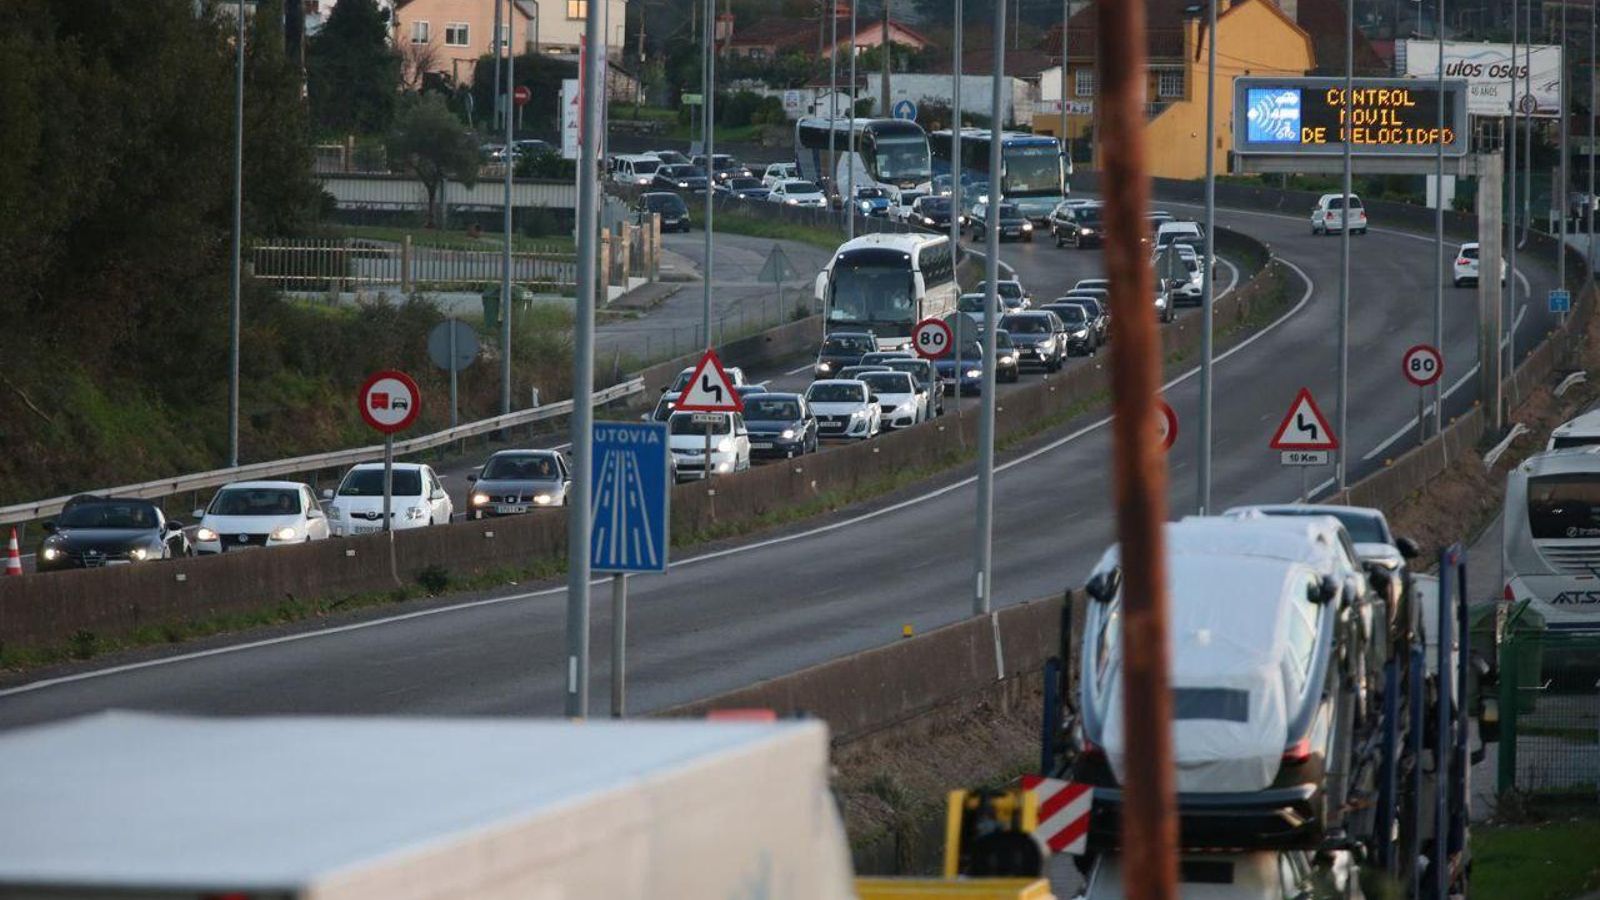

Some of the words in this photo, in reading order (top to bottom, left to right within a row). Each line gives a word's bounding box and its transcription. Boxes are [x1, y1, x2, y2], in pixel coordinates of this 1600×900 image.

[1301, 127, 1326, 144] DE
[920, 332, 944, 345] 80
[1411, 358, 1435, 372] 80
[595, 428, 659, 444] UTOVIA
[1289, 453, 1299, 462] 10
[1552, 591, 1600, 604] ATS
